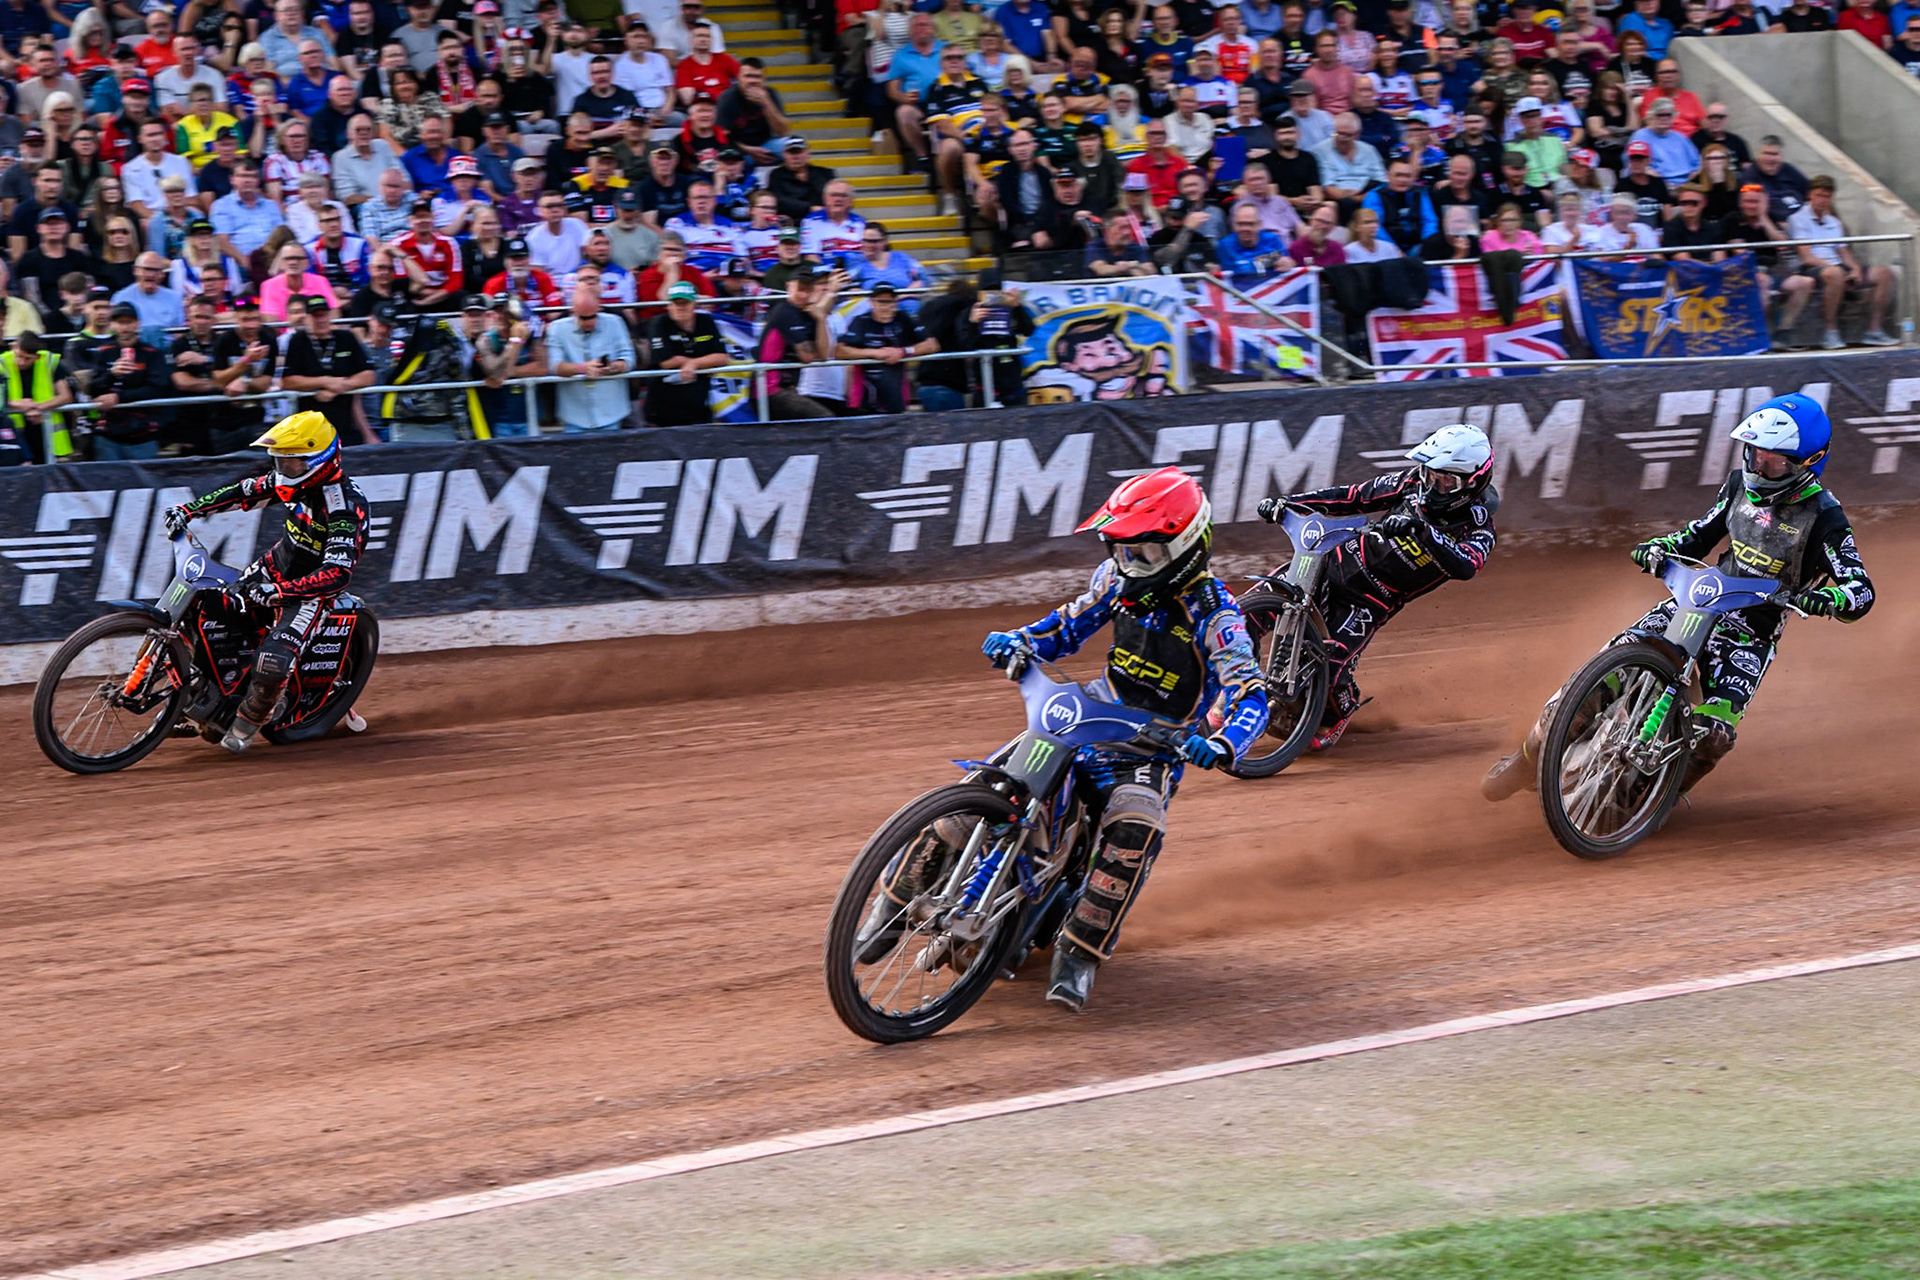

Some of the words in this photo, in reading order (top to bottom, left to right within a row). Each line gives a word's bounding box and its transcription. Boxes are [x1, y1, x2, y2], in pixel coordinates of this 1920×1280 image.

[855, 432, 1095, 553] FIM
[564, 454, 820, 570] FIM
[1304, 529, 1321, 540] ATPI
[1777, 522, 1801, 535] SGP
[1693, 584, 1717, 597] ATPI
[1047, 703, 1075, 723] ATPI
